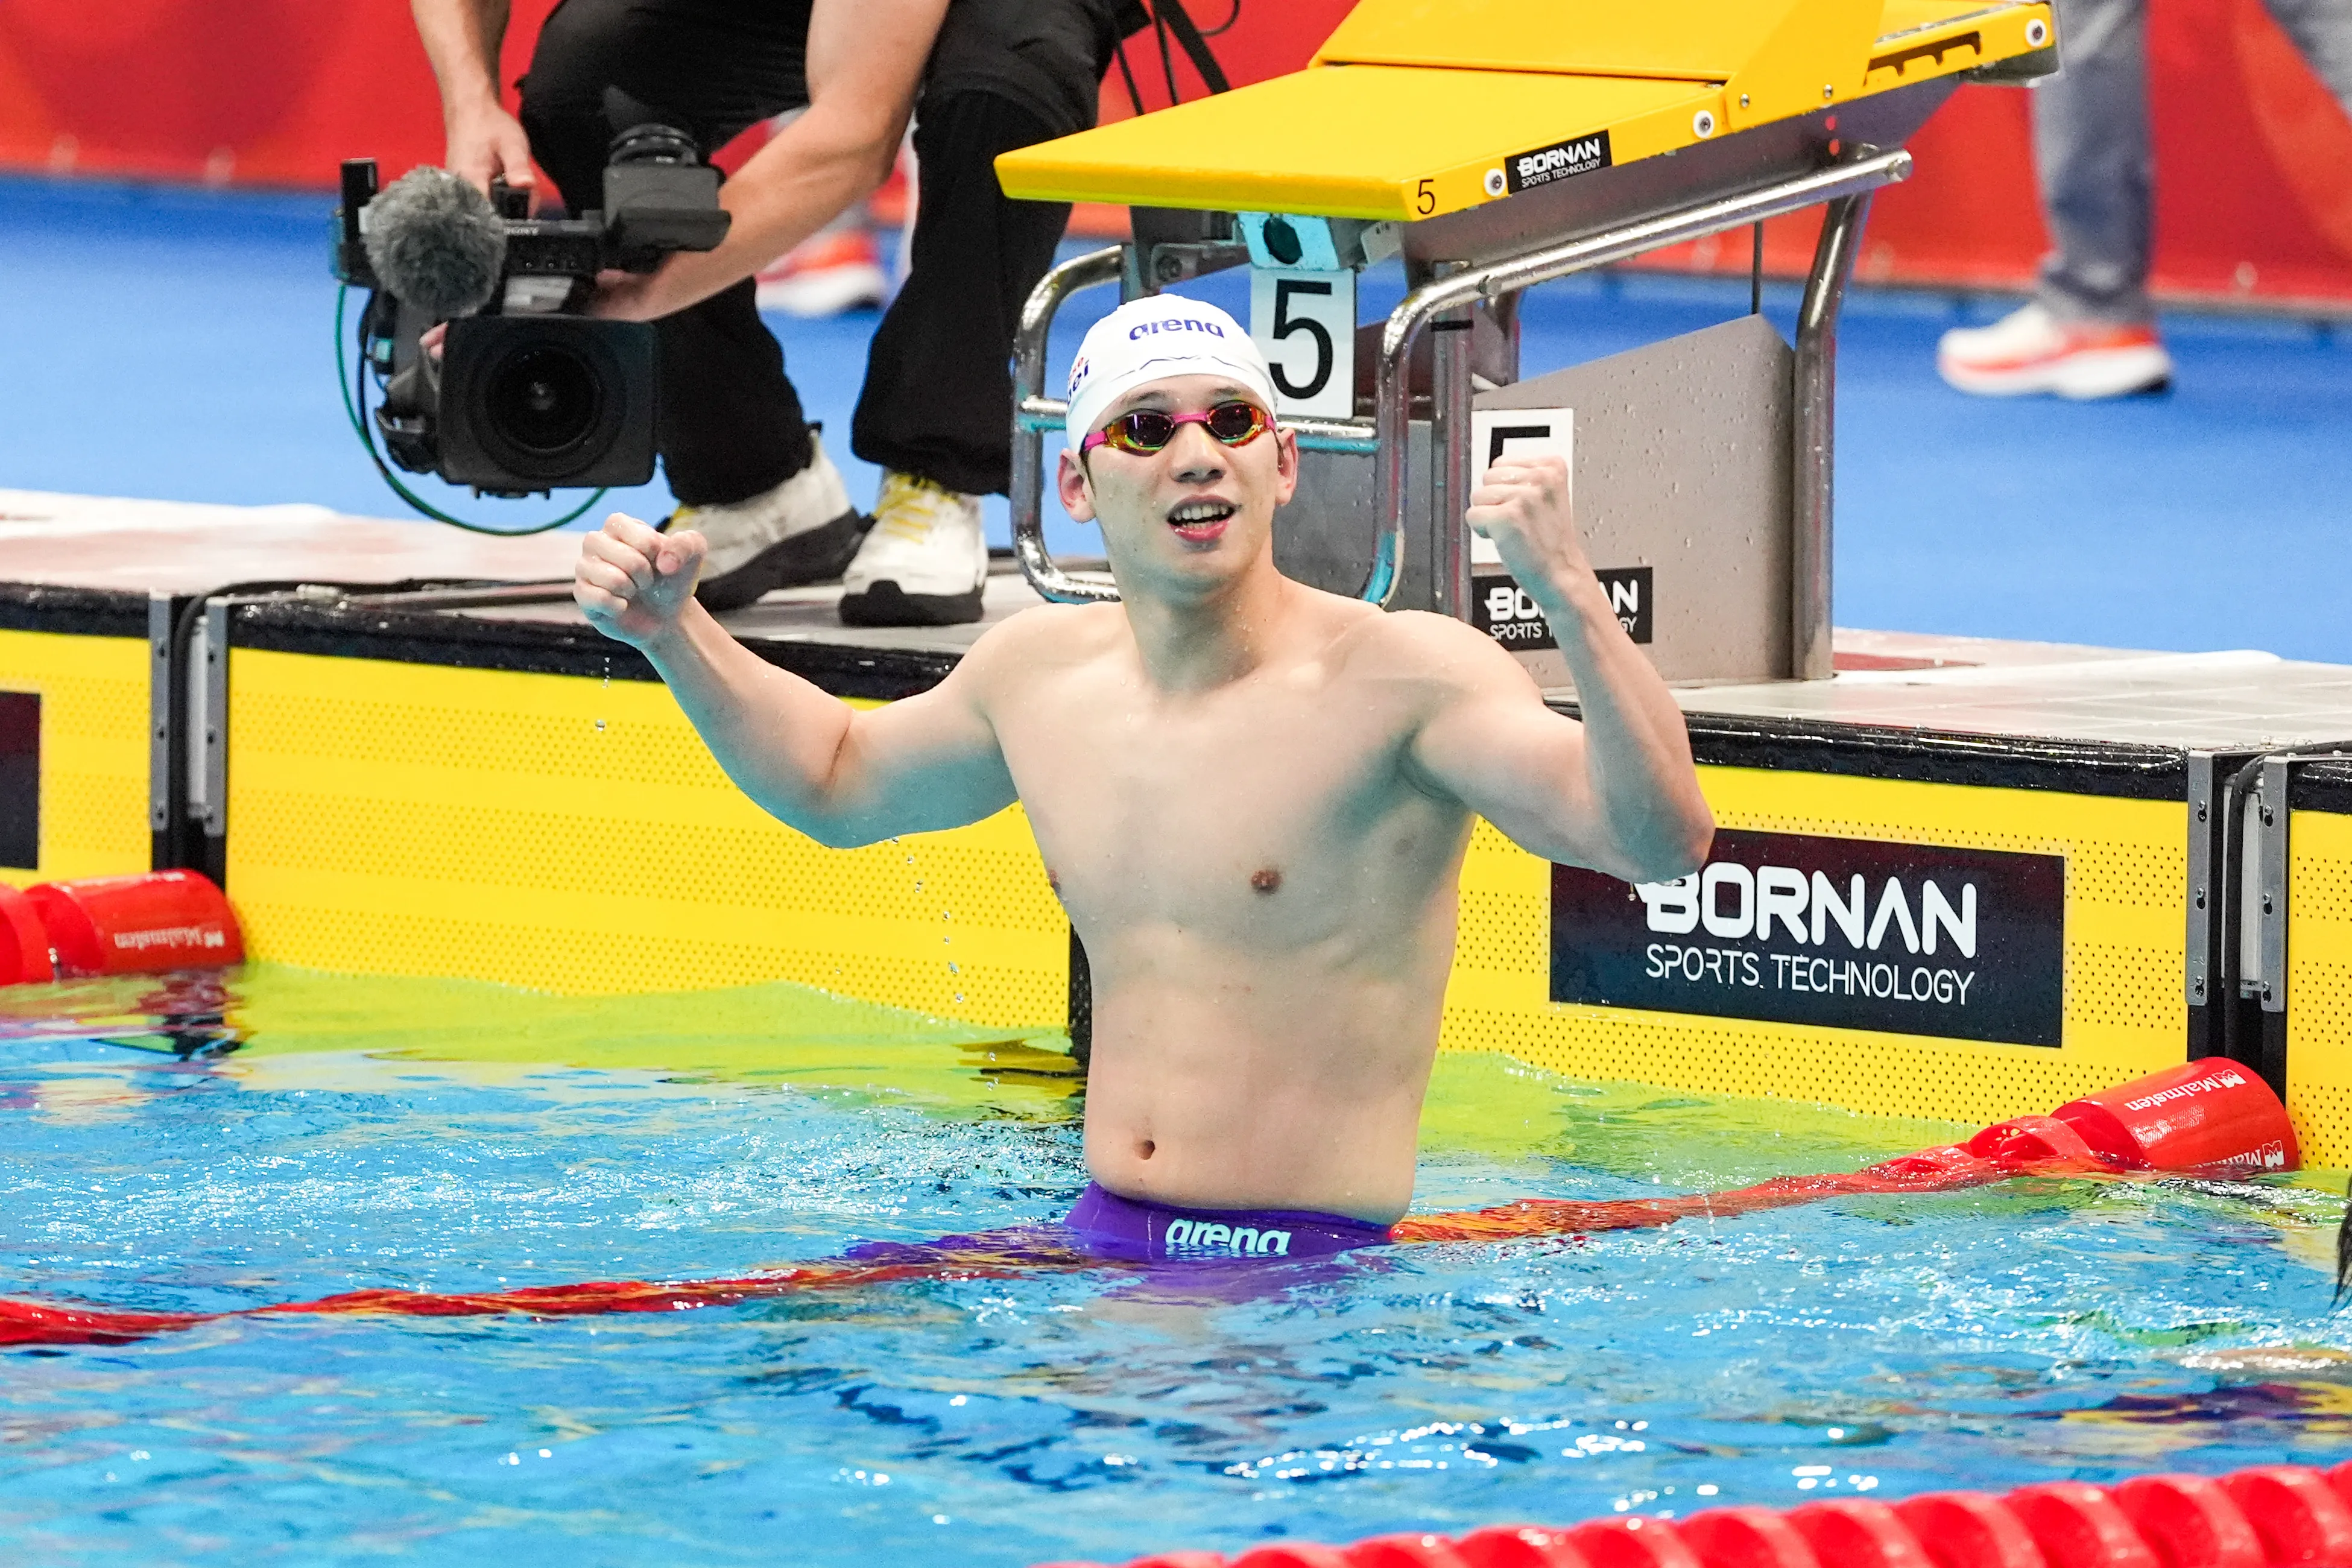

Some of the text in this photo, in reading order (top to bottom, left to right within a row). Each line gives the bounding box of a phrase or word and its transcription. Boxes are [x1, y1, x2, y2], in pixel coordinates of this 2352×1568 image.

[1517, 138, 1601, 177] BORNAN
[1522, 158, 1601, 188] SPORTS TECHNOLOGY
[1417, 179, 1435, 214] 5
[1130, 319, 1224, 340] arena
[1269, 279, 1333, 399] 5
[1490, 622, 1542, 640] SPORTS
[1634, 862, 1977, 959] BORNAN
[1645, 943, 1975, 1005] SPORTS TECHNOLOGY
[2124, 1076, 2223, 1111] Malmsten
[1166, 1219, 1291, 1256] arena
